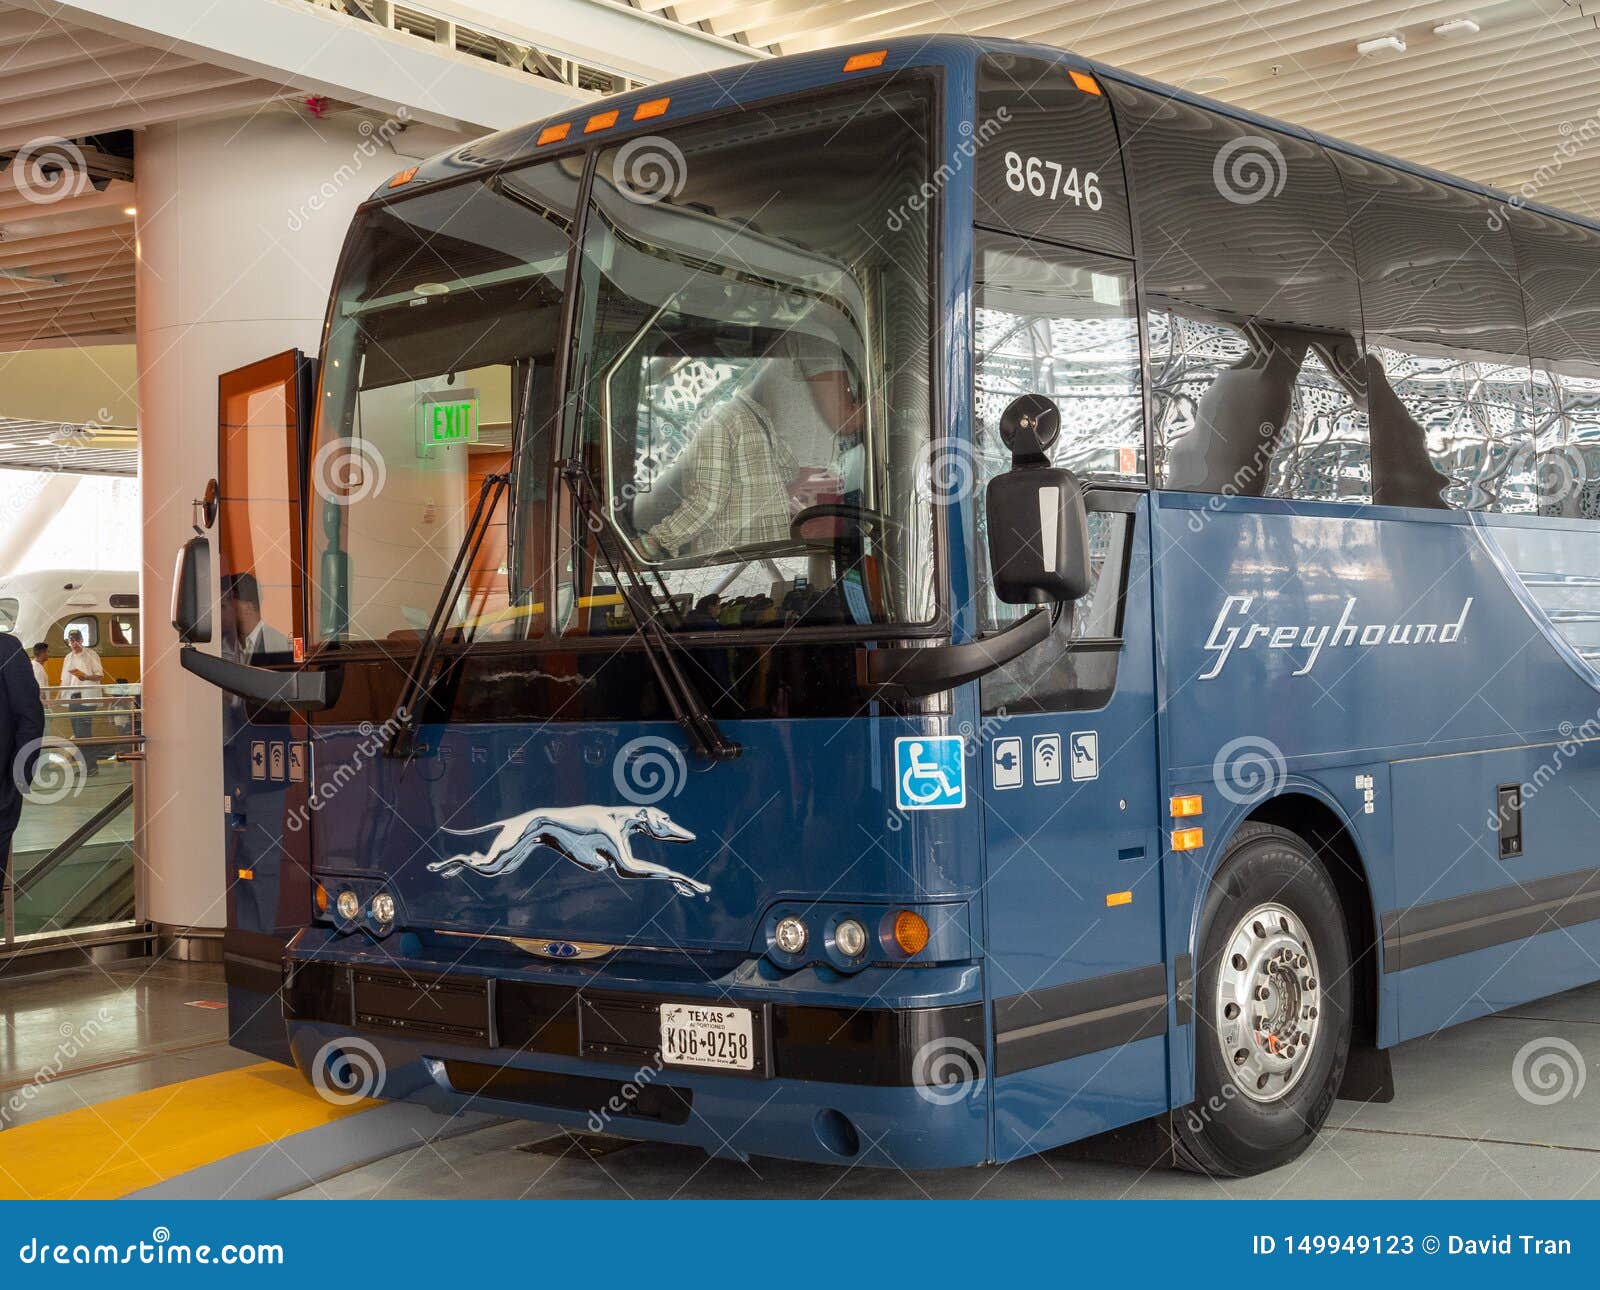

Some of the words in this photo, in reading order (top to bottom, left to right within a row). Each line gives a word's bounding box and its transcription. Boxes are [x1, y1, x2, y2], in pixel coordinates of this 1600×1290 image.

[1005, 151, 1103, 211] 86746
[433, 404, 472, 440] EXIT
[1198, 595, 1474, 680] Greyhound
[688, 1010, 724, 1023] TEXAS
